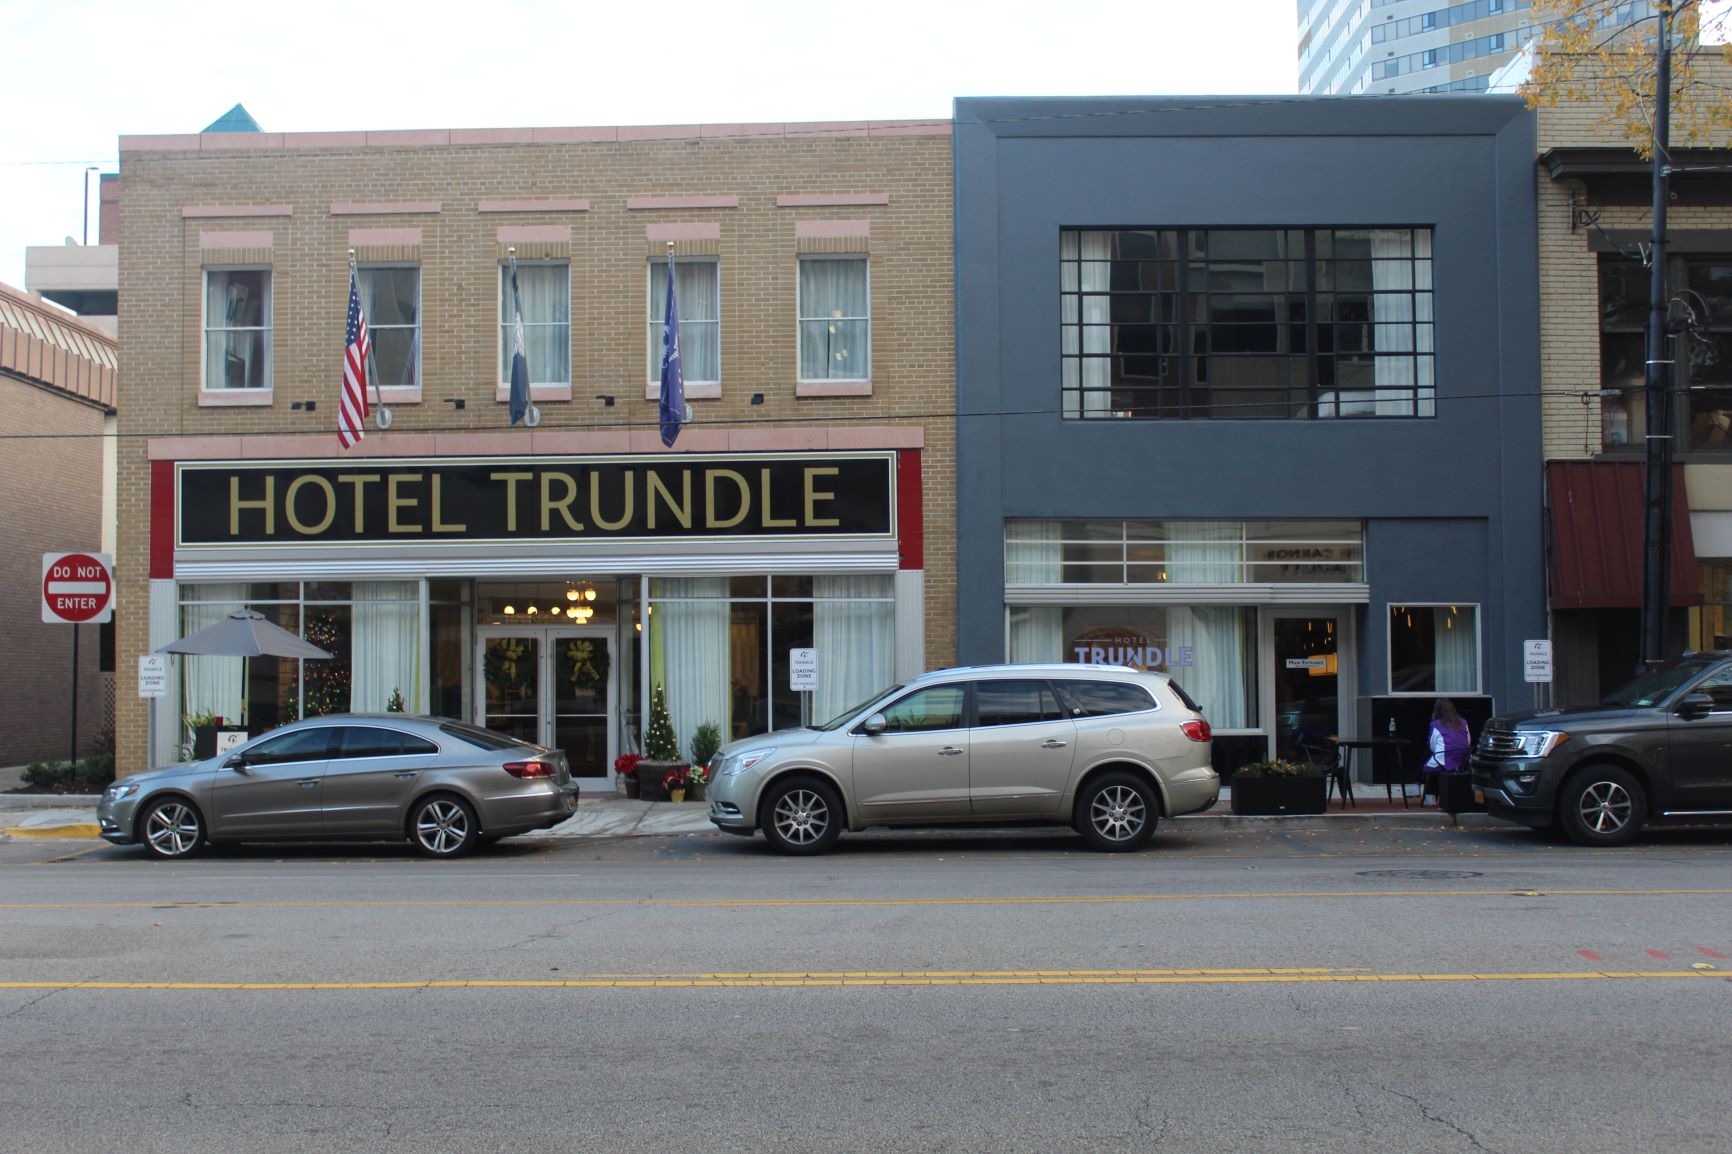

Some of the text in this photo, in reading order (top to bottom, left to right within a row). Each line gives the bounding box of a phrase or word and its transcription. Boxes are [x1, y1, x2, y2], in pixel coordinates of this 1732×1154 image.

[229, 466, 841, 536] HOTEL TRUNDLE
[53, 566, 102, 578] DO NOT
[57, 597, 97, 609] ENTER
[1074, 646, 1193, 667] TRUNDLE
